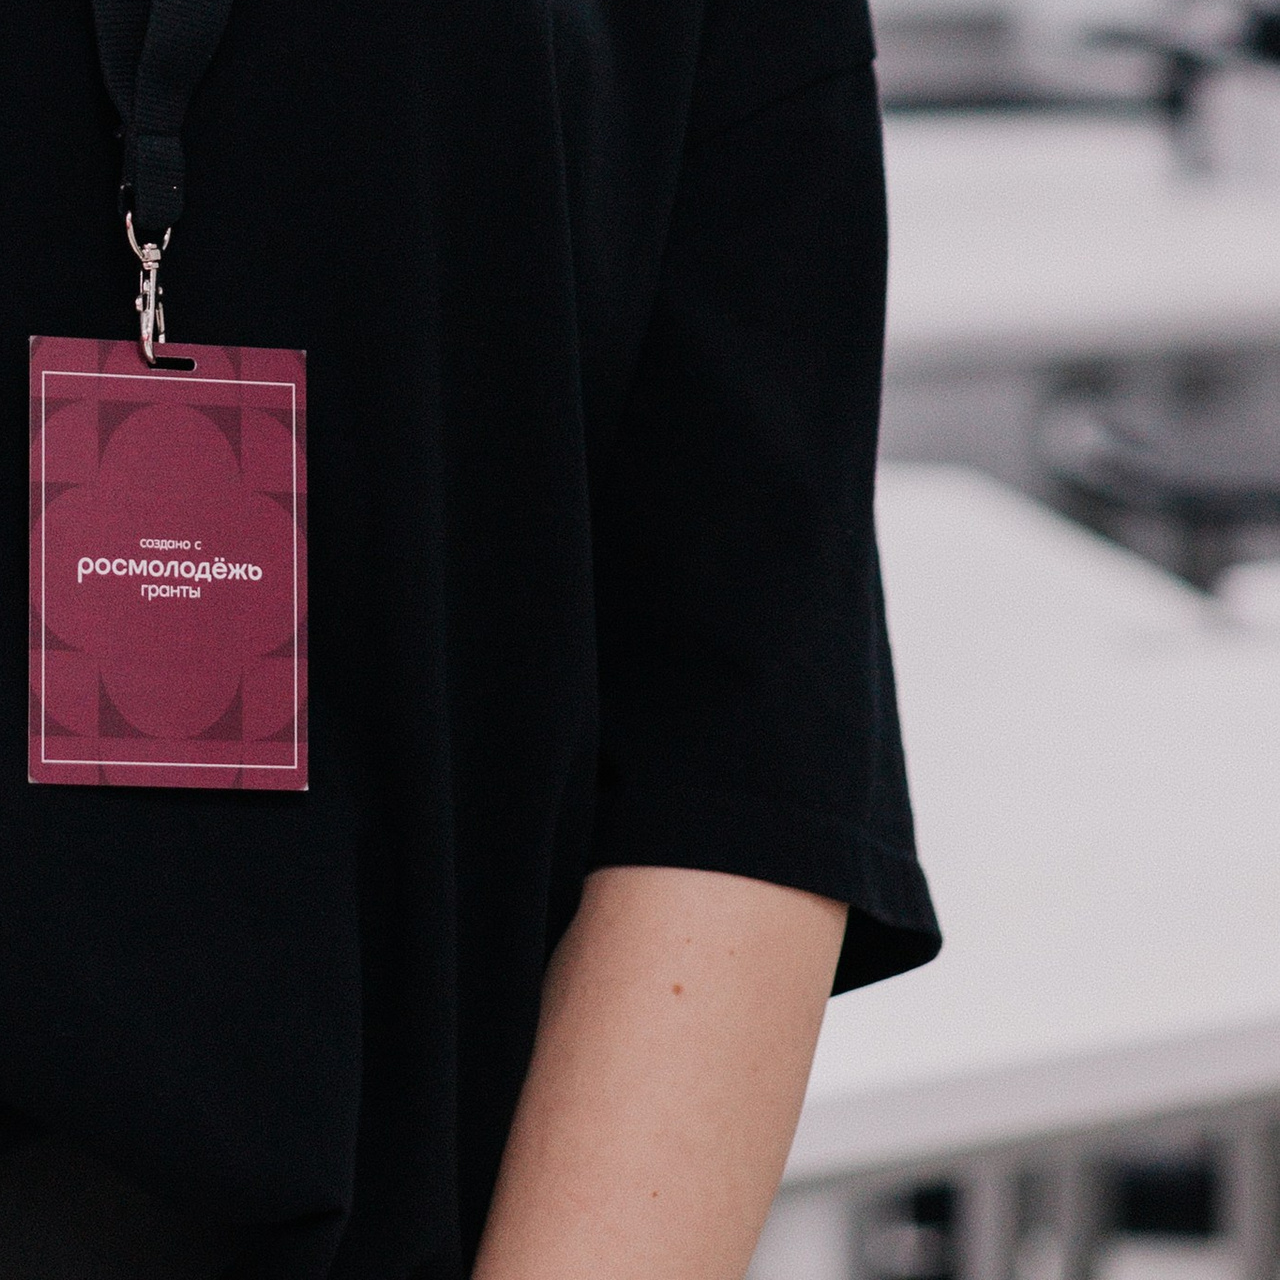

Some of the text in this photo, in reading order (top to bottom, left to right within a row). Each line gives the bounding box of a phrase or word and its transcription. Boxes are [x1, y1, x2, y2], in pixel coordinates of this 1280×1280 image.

[140, 538, 202, 551] создано с
[78, 557, 263, 584] росмолодёжь
[140, 584, 201, 602] гранты
